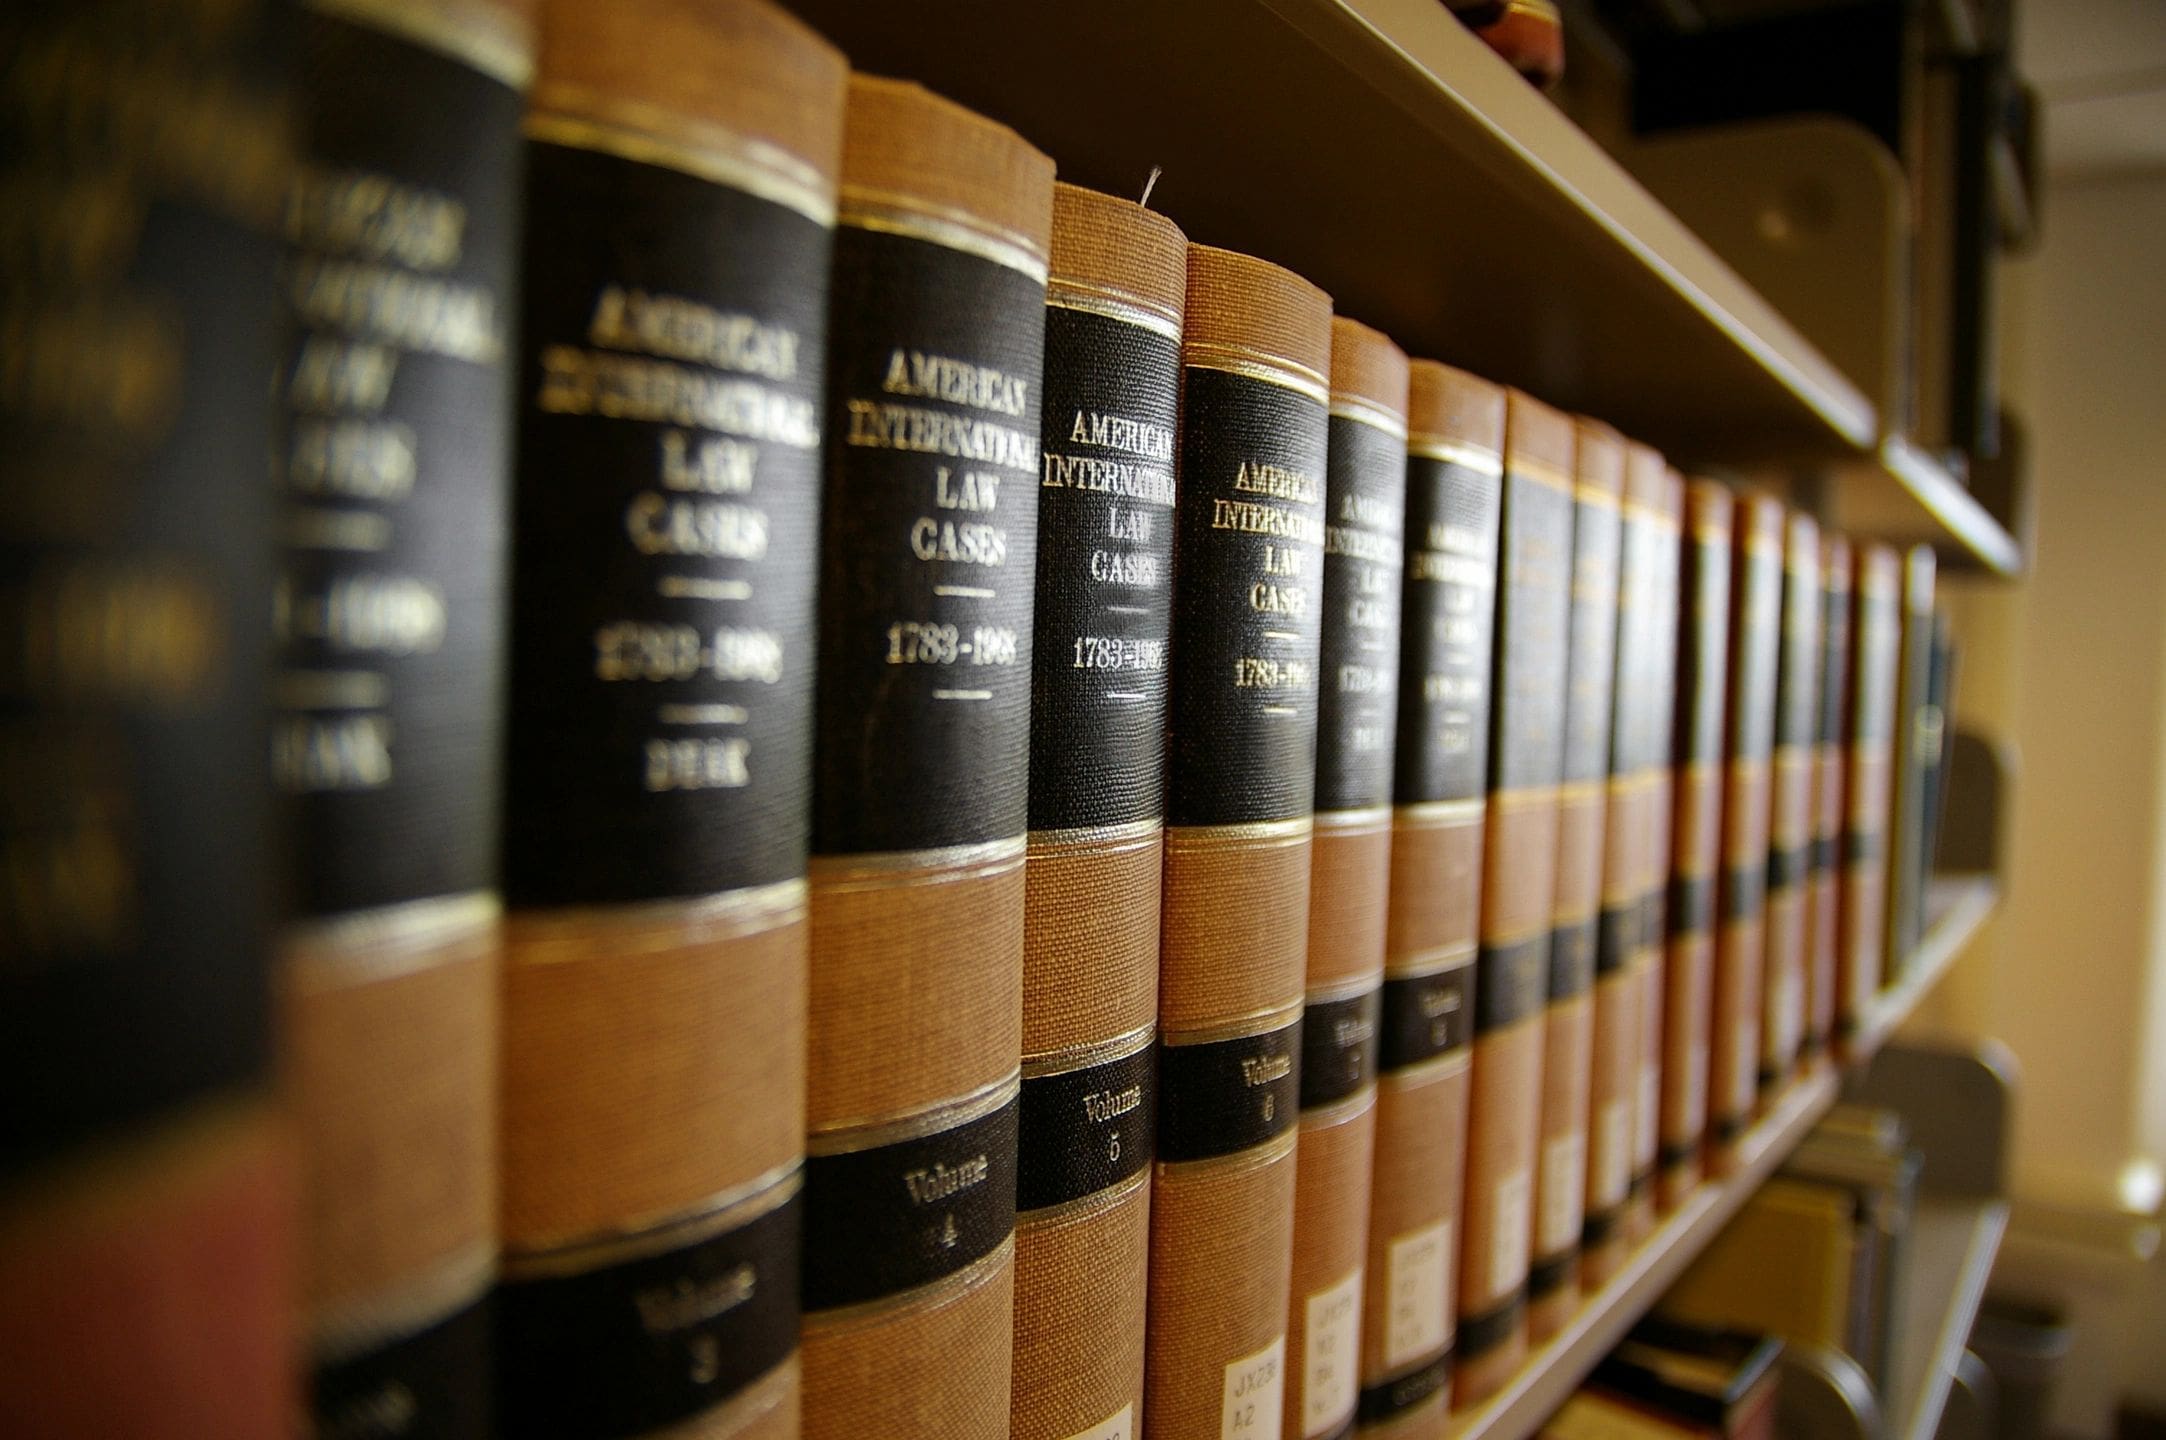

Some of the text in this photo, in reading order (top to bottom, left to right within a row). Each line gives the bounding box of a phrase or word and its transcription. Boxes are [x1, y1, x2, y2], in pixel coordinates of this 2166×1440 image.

[882, 348, 1027, 417] AMERICAN
[935, 466, 1000, 513] LAW
[910, 516, 1006, 567] CASES
[1108, 506, 1151, 542] LAW
[1091, 549, 1157, 588] CASES
[1242, 1055, 1291, 1088] Volume
[1083, 1085, 1141, 1122] Volume
[1107, 1128, 1121, 1162] 5
[905, 1154, 989, 1207] Volume
[941, 1212, 958, 1249] 4
[1231, 1403, 1256, 1432] A2
